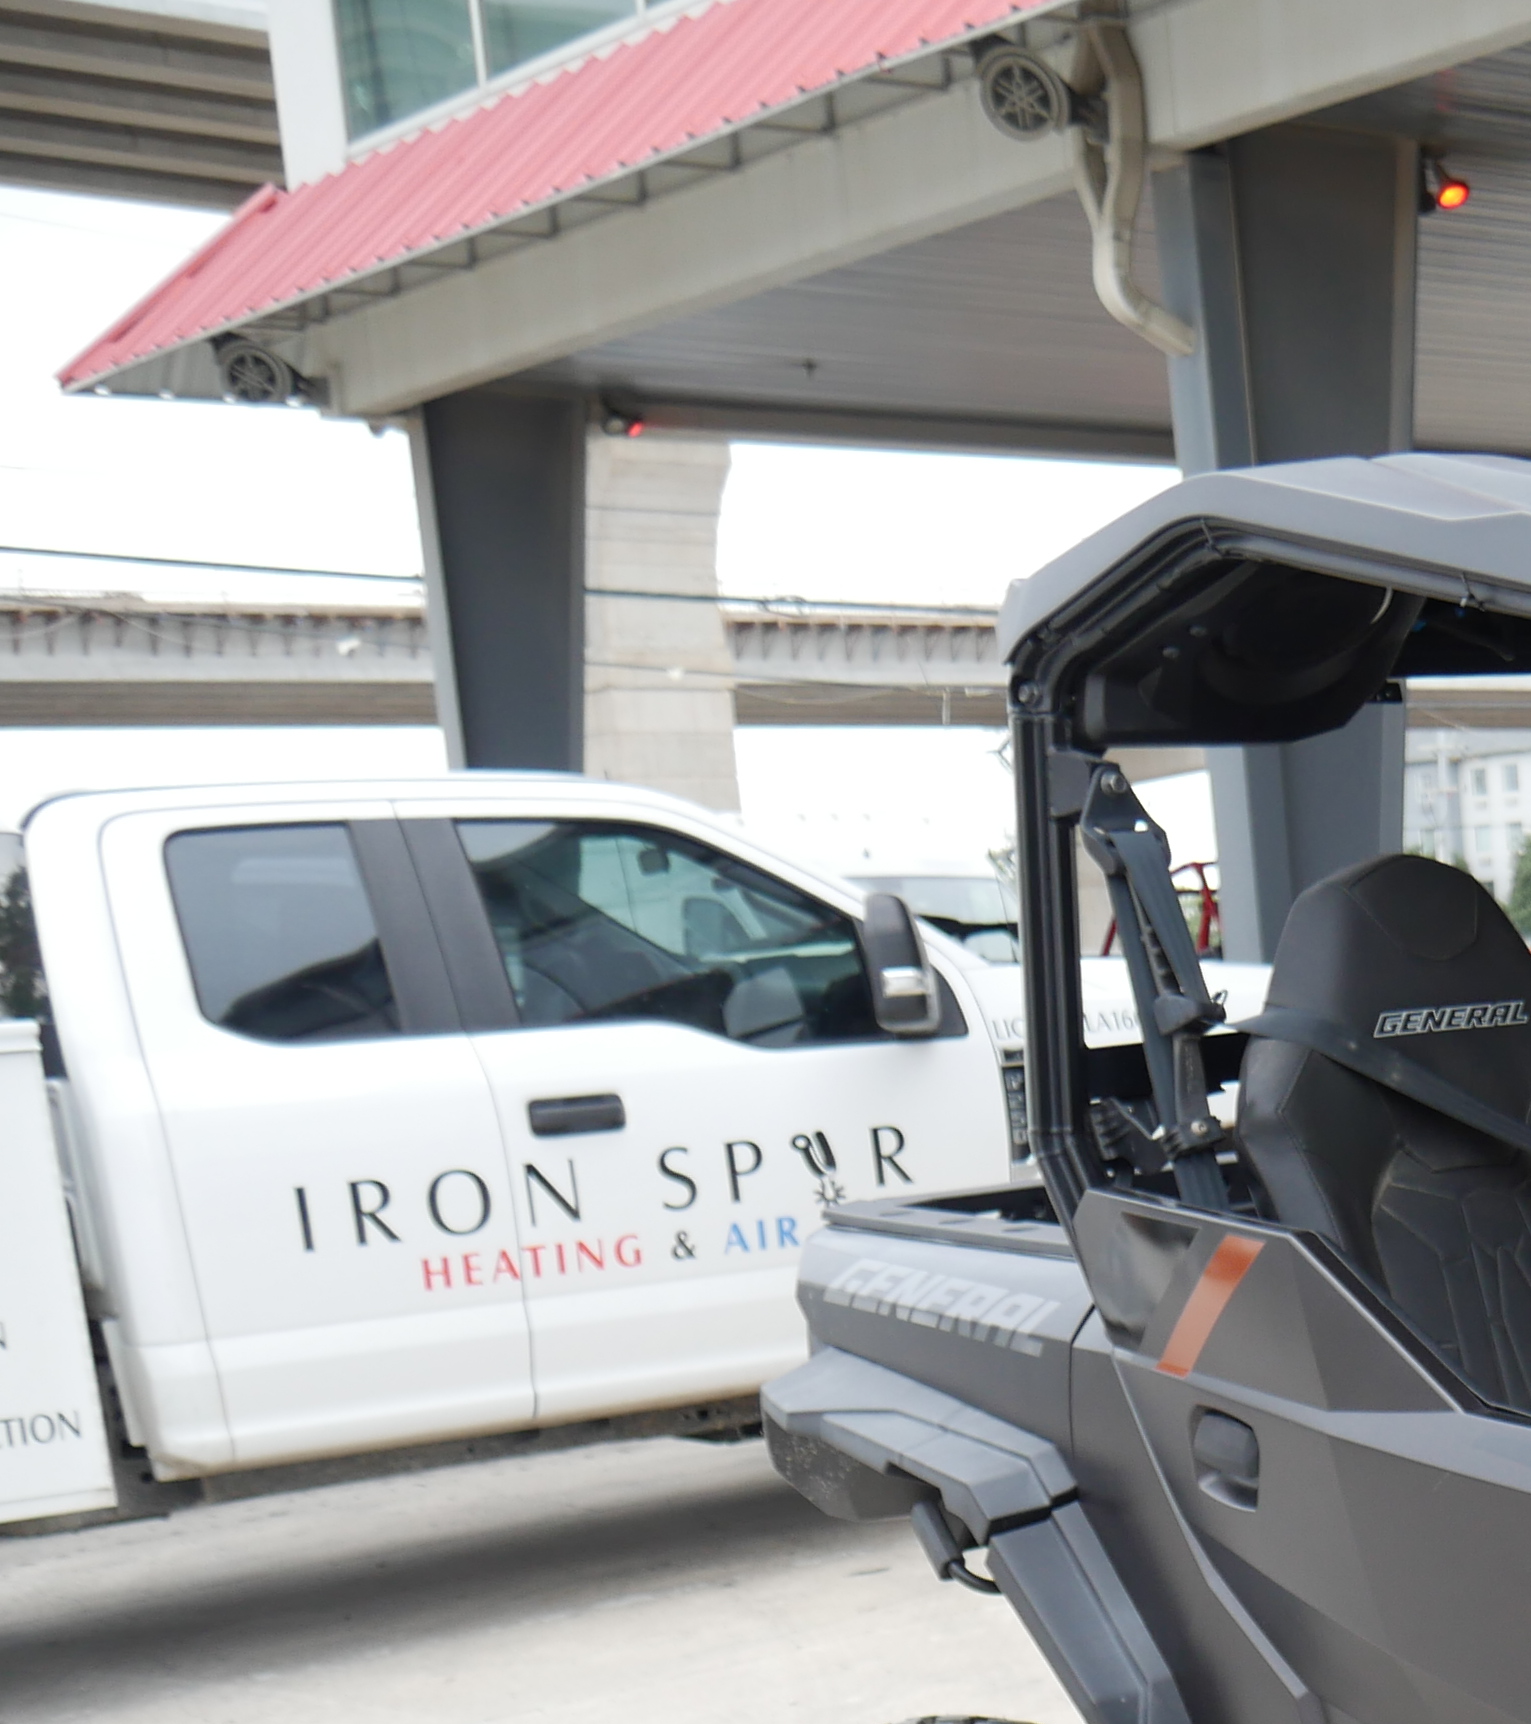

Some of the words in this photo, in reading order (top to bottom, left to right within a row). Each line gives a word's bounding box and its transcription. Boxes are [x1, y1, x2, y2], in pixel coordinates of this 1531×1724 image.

[1373, 1000, 1530, 1039] GENERAL
[294, 1158, 583, 1252] IRON
[421, 1234, 643, 1292] HEATING
[671, 1230, 697, 1260] &
[724, 1216, 800, 1256] AIR
[0, 1410, 81, 1449] TION
